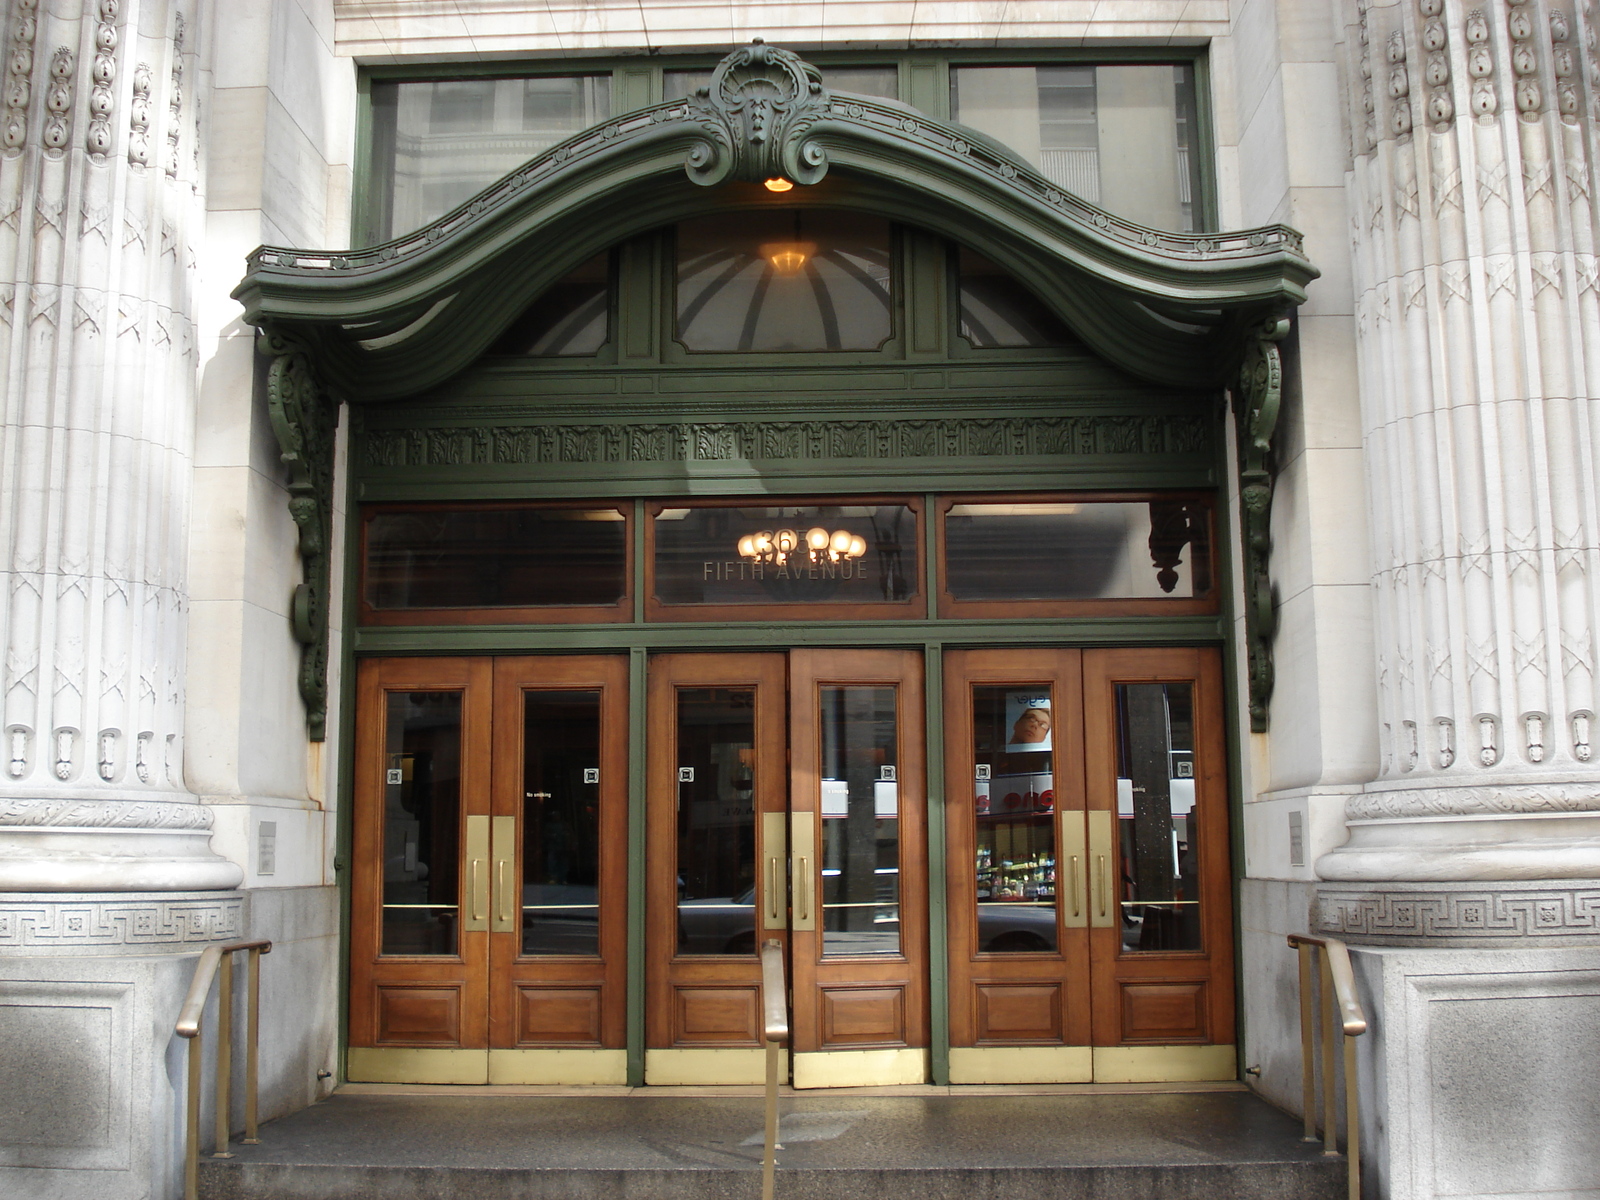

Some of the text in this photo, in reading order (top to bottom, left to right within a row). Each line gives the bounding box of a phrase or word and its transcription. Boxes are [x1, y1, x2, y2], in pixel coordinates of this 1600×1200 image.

[761, 529, 810, 555] 365
[703, 560, 868, 581] FIFTH AVENUE
